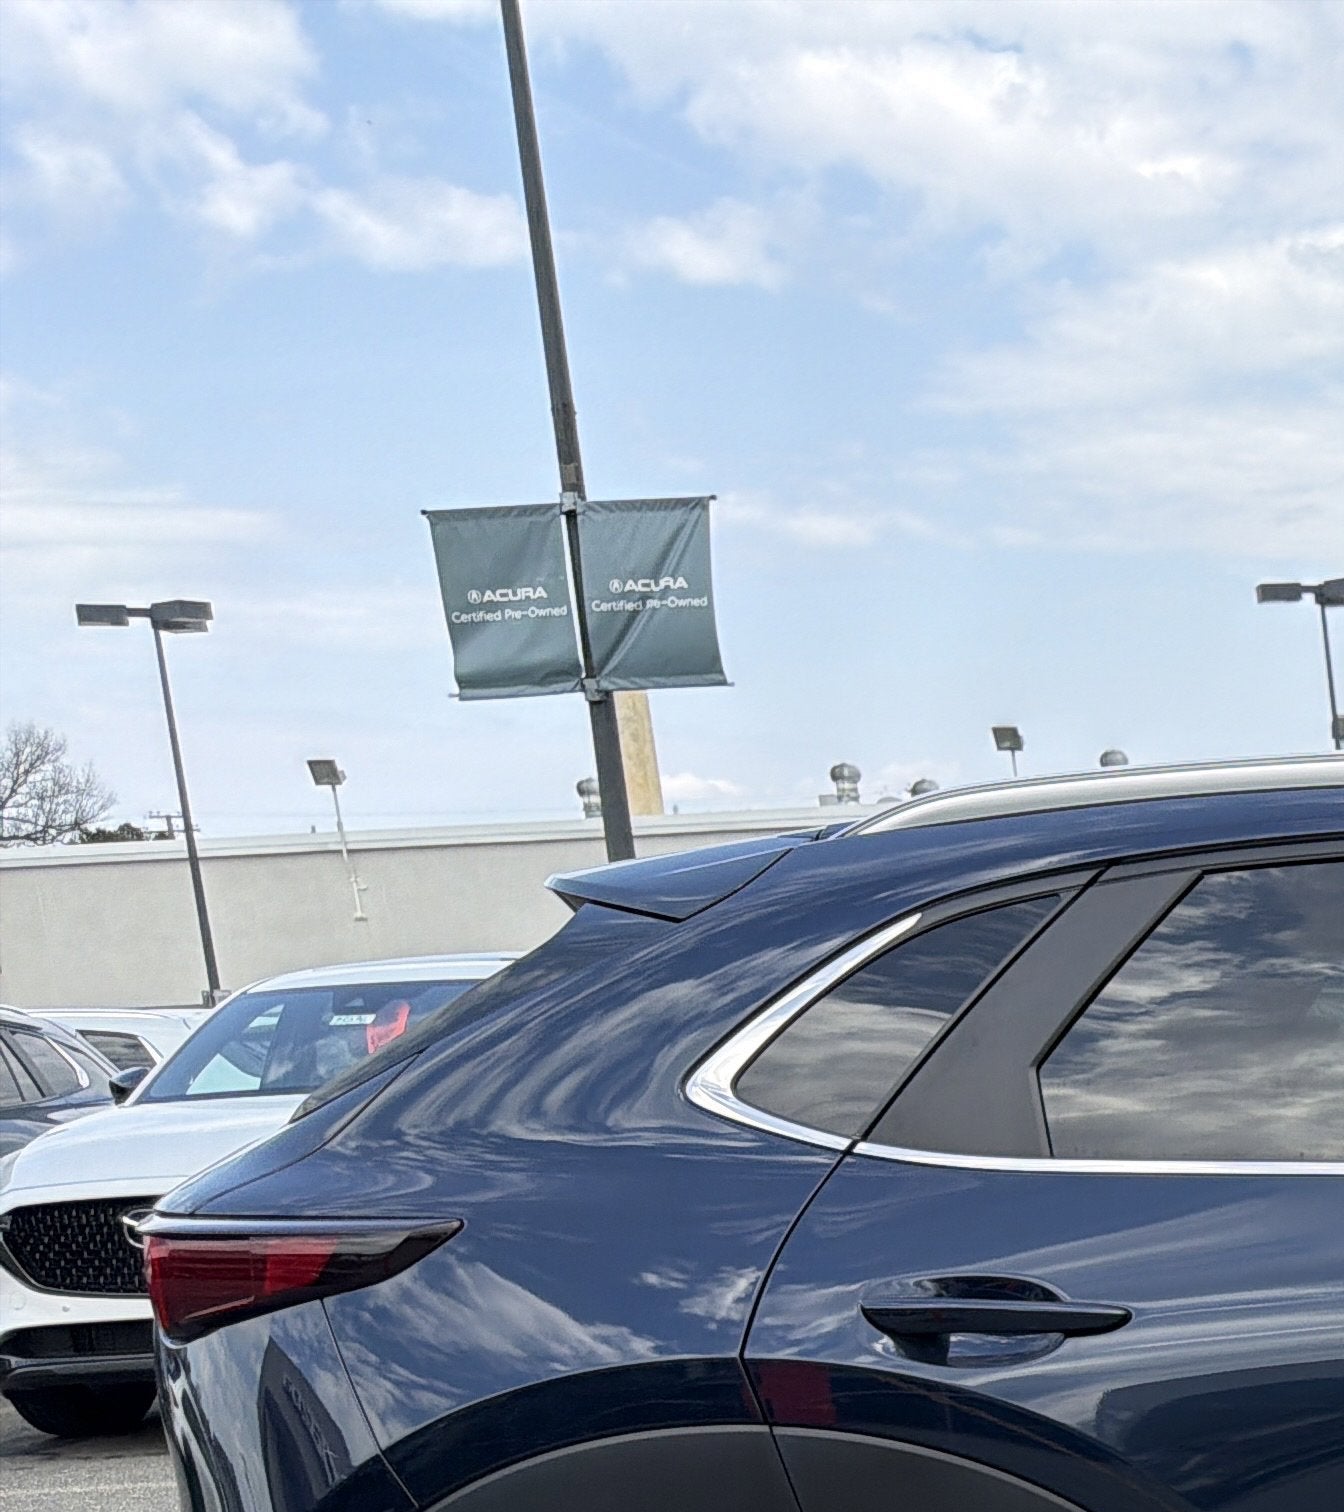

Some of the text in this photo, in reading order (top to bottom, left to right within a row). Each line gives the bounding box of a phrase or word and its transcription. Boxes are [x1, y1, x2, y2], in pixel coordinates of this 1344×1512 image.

[624, 576, 688, 592] ACURA
[482, 586, 547, 603] ACURA
[591, 600, 643, 612] Certified
[451, 605, 567, 624] Certified Pre-Owned
